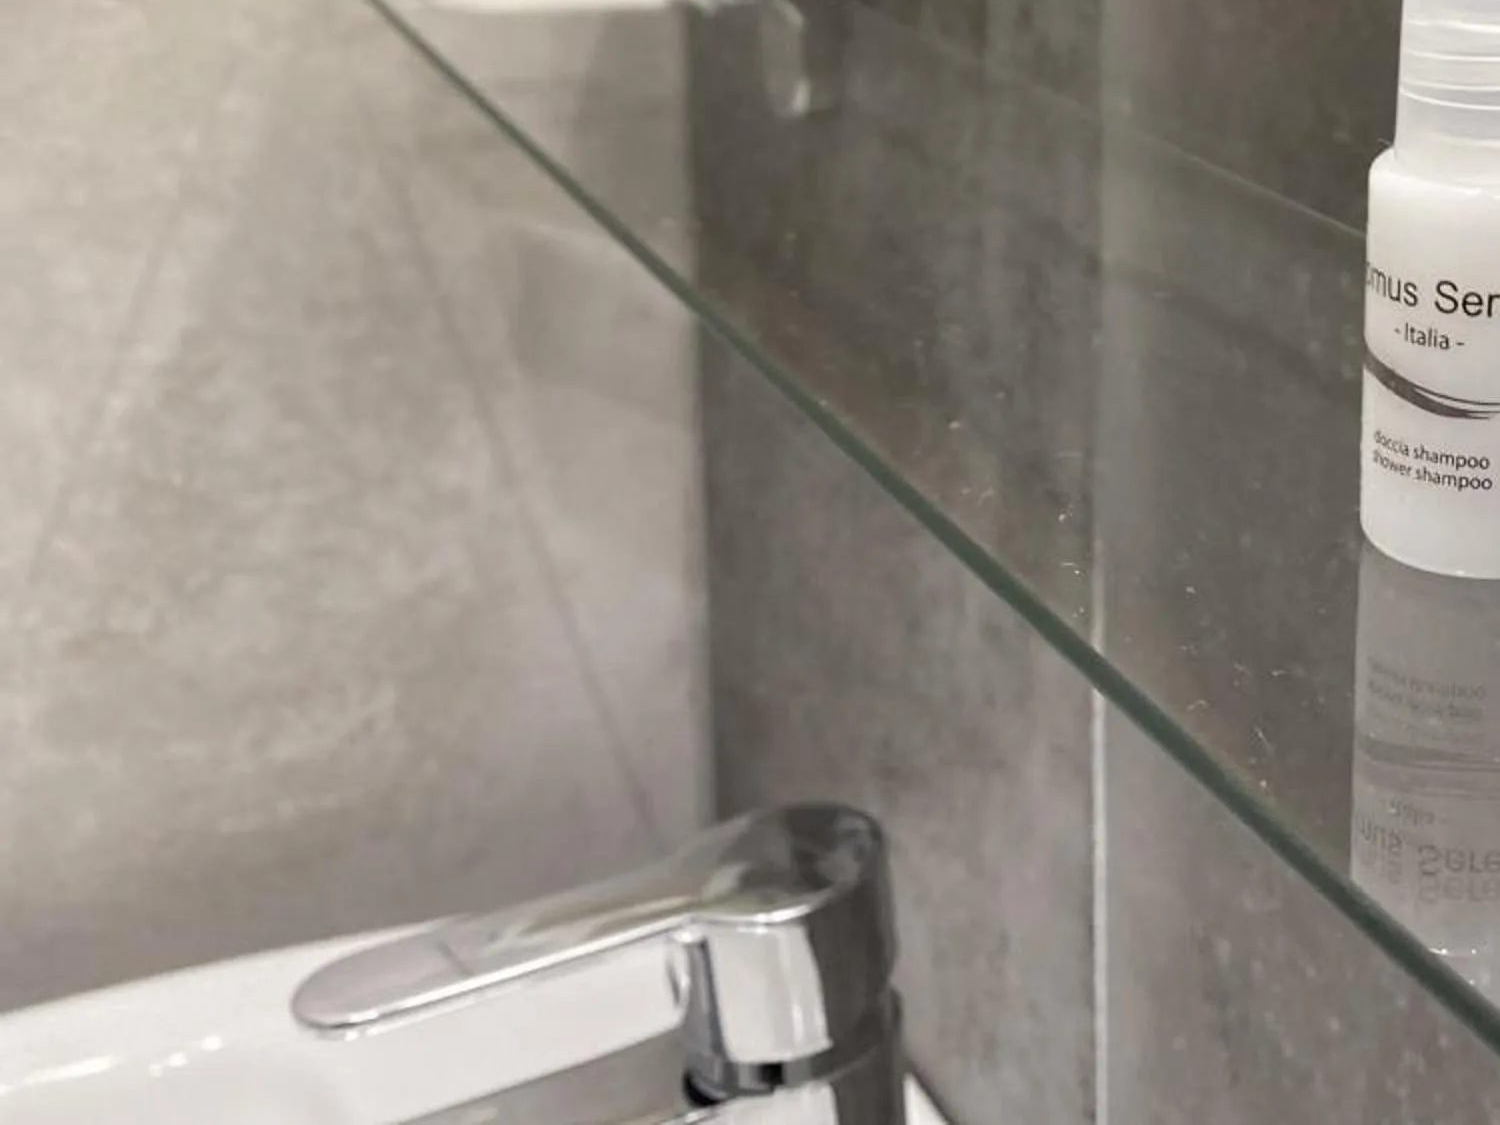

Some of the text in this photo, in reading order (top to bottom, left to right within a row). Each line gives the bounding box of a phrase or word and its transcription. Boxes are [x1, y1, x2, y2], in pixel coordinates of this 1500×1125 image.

[1365, 262, 1418, 307] mus
[1413, 443, 1490, 471] shampoo
[1415, 466, 1493, 492] shampoo
